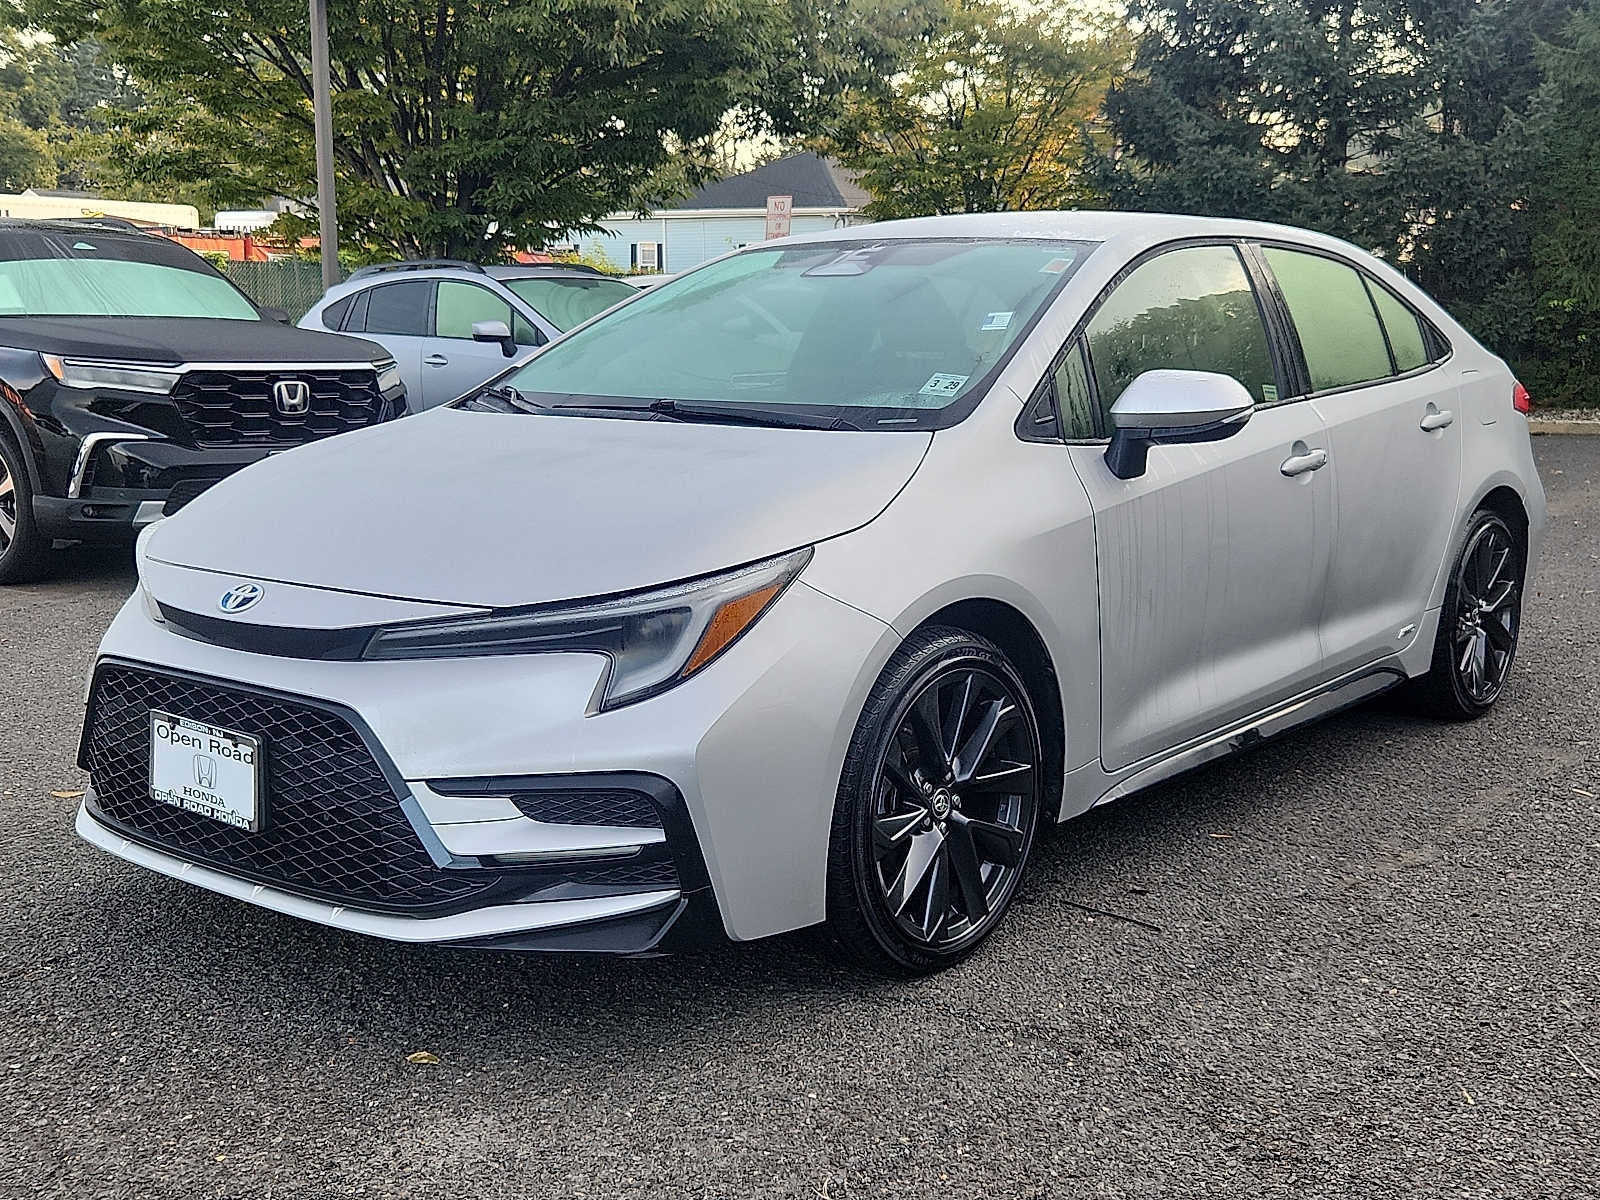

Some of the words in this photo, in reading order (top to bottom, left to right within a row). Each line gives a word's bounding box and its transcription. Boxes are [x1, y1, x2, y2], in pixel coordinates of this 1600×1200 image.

[930, 379, 940, 388] 3
[212, 728, 224, 738] NJ
[157, 724, 202, 749] Open
[209, 738, 254, 765] Road
[183, 786, 226, 808] HONDA
[154, 789, 181, 807] OPEN
[183, 800, 212, 817] ROAD
[213, 810, 250, 830] HONDA
